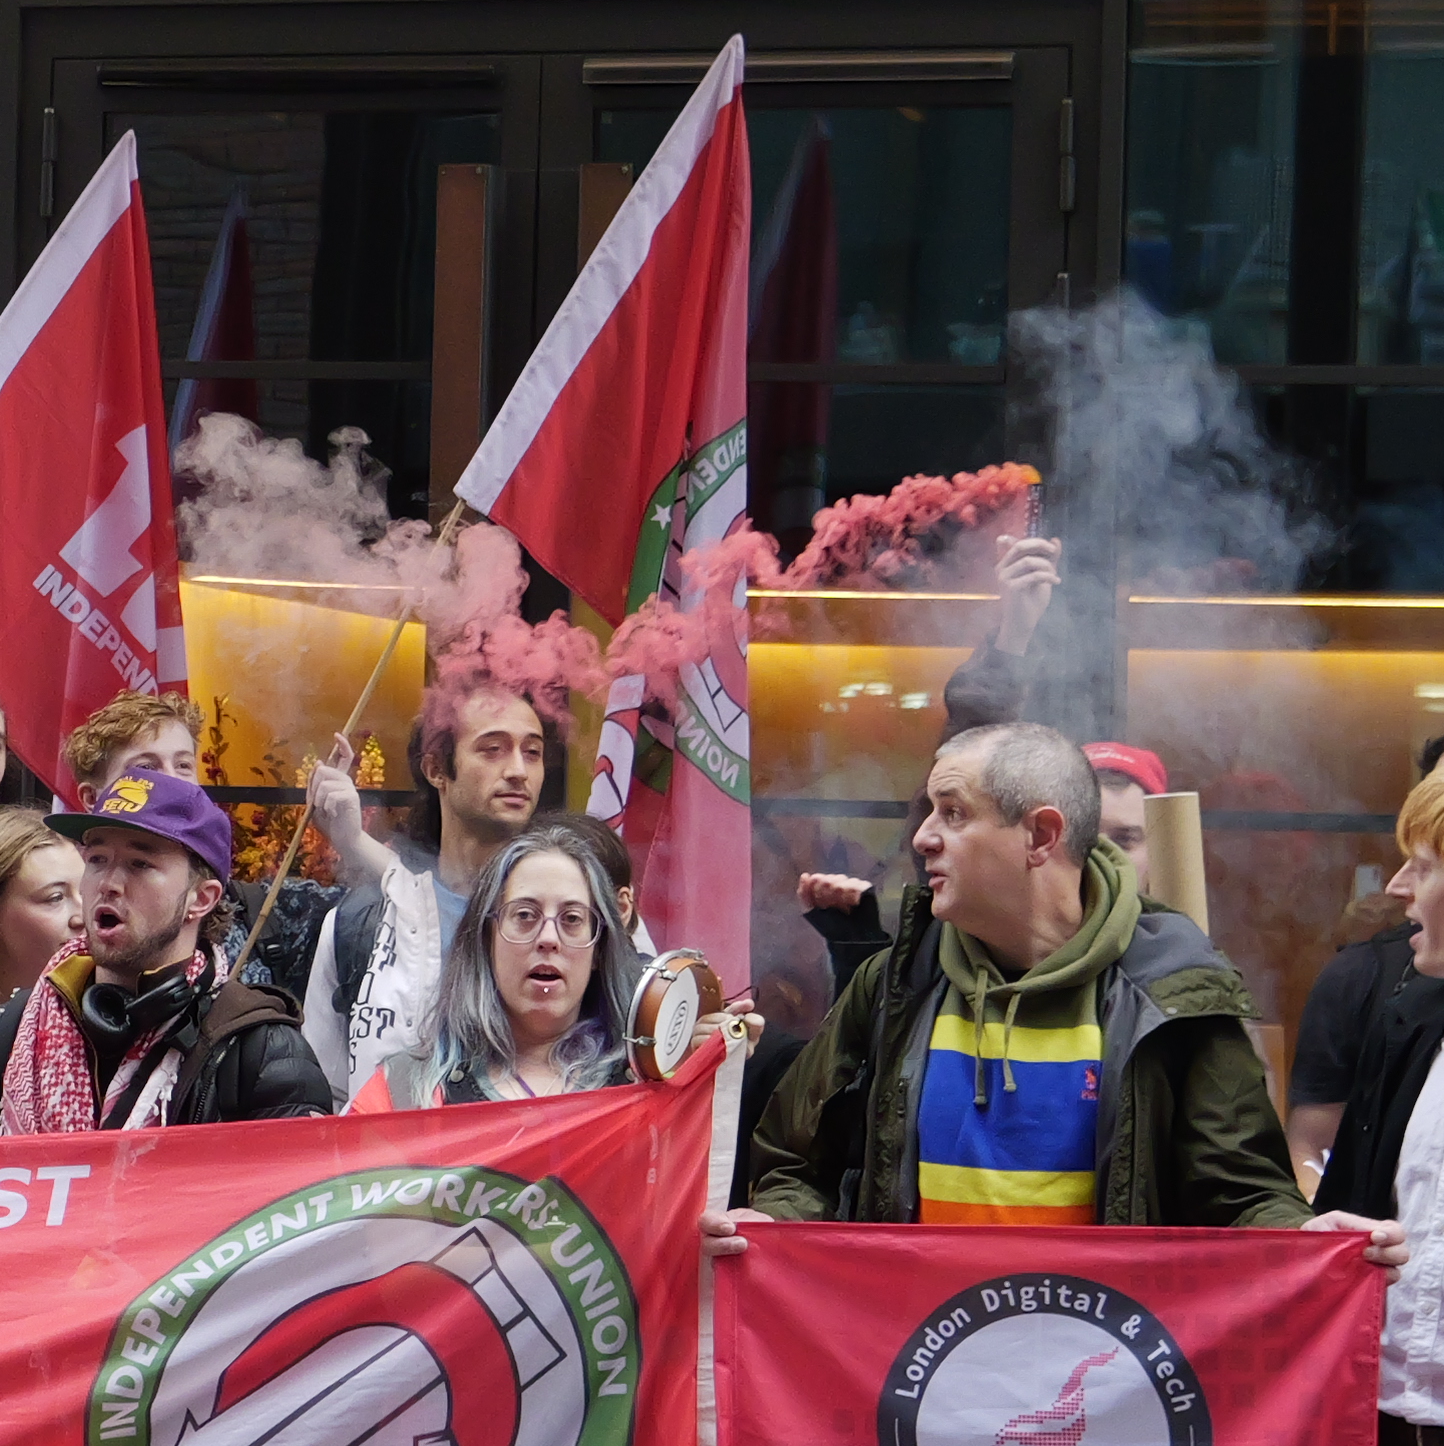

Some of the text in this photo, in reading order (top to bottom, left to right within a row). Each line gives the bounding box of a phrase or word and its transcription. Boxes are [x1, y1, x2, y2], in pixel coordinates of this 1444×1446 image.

[99, 1173, 629, 1441] INDEPENDENT WORKRS UNION
[894, 1279, 1196, 1414] London Digital & Tech
